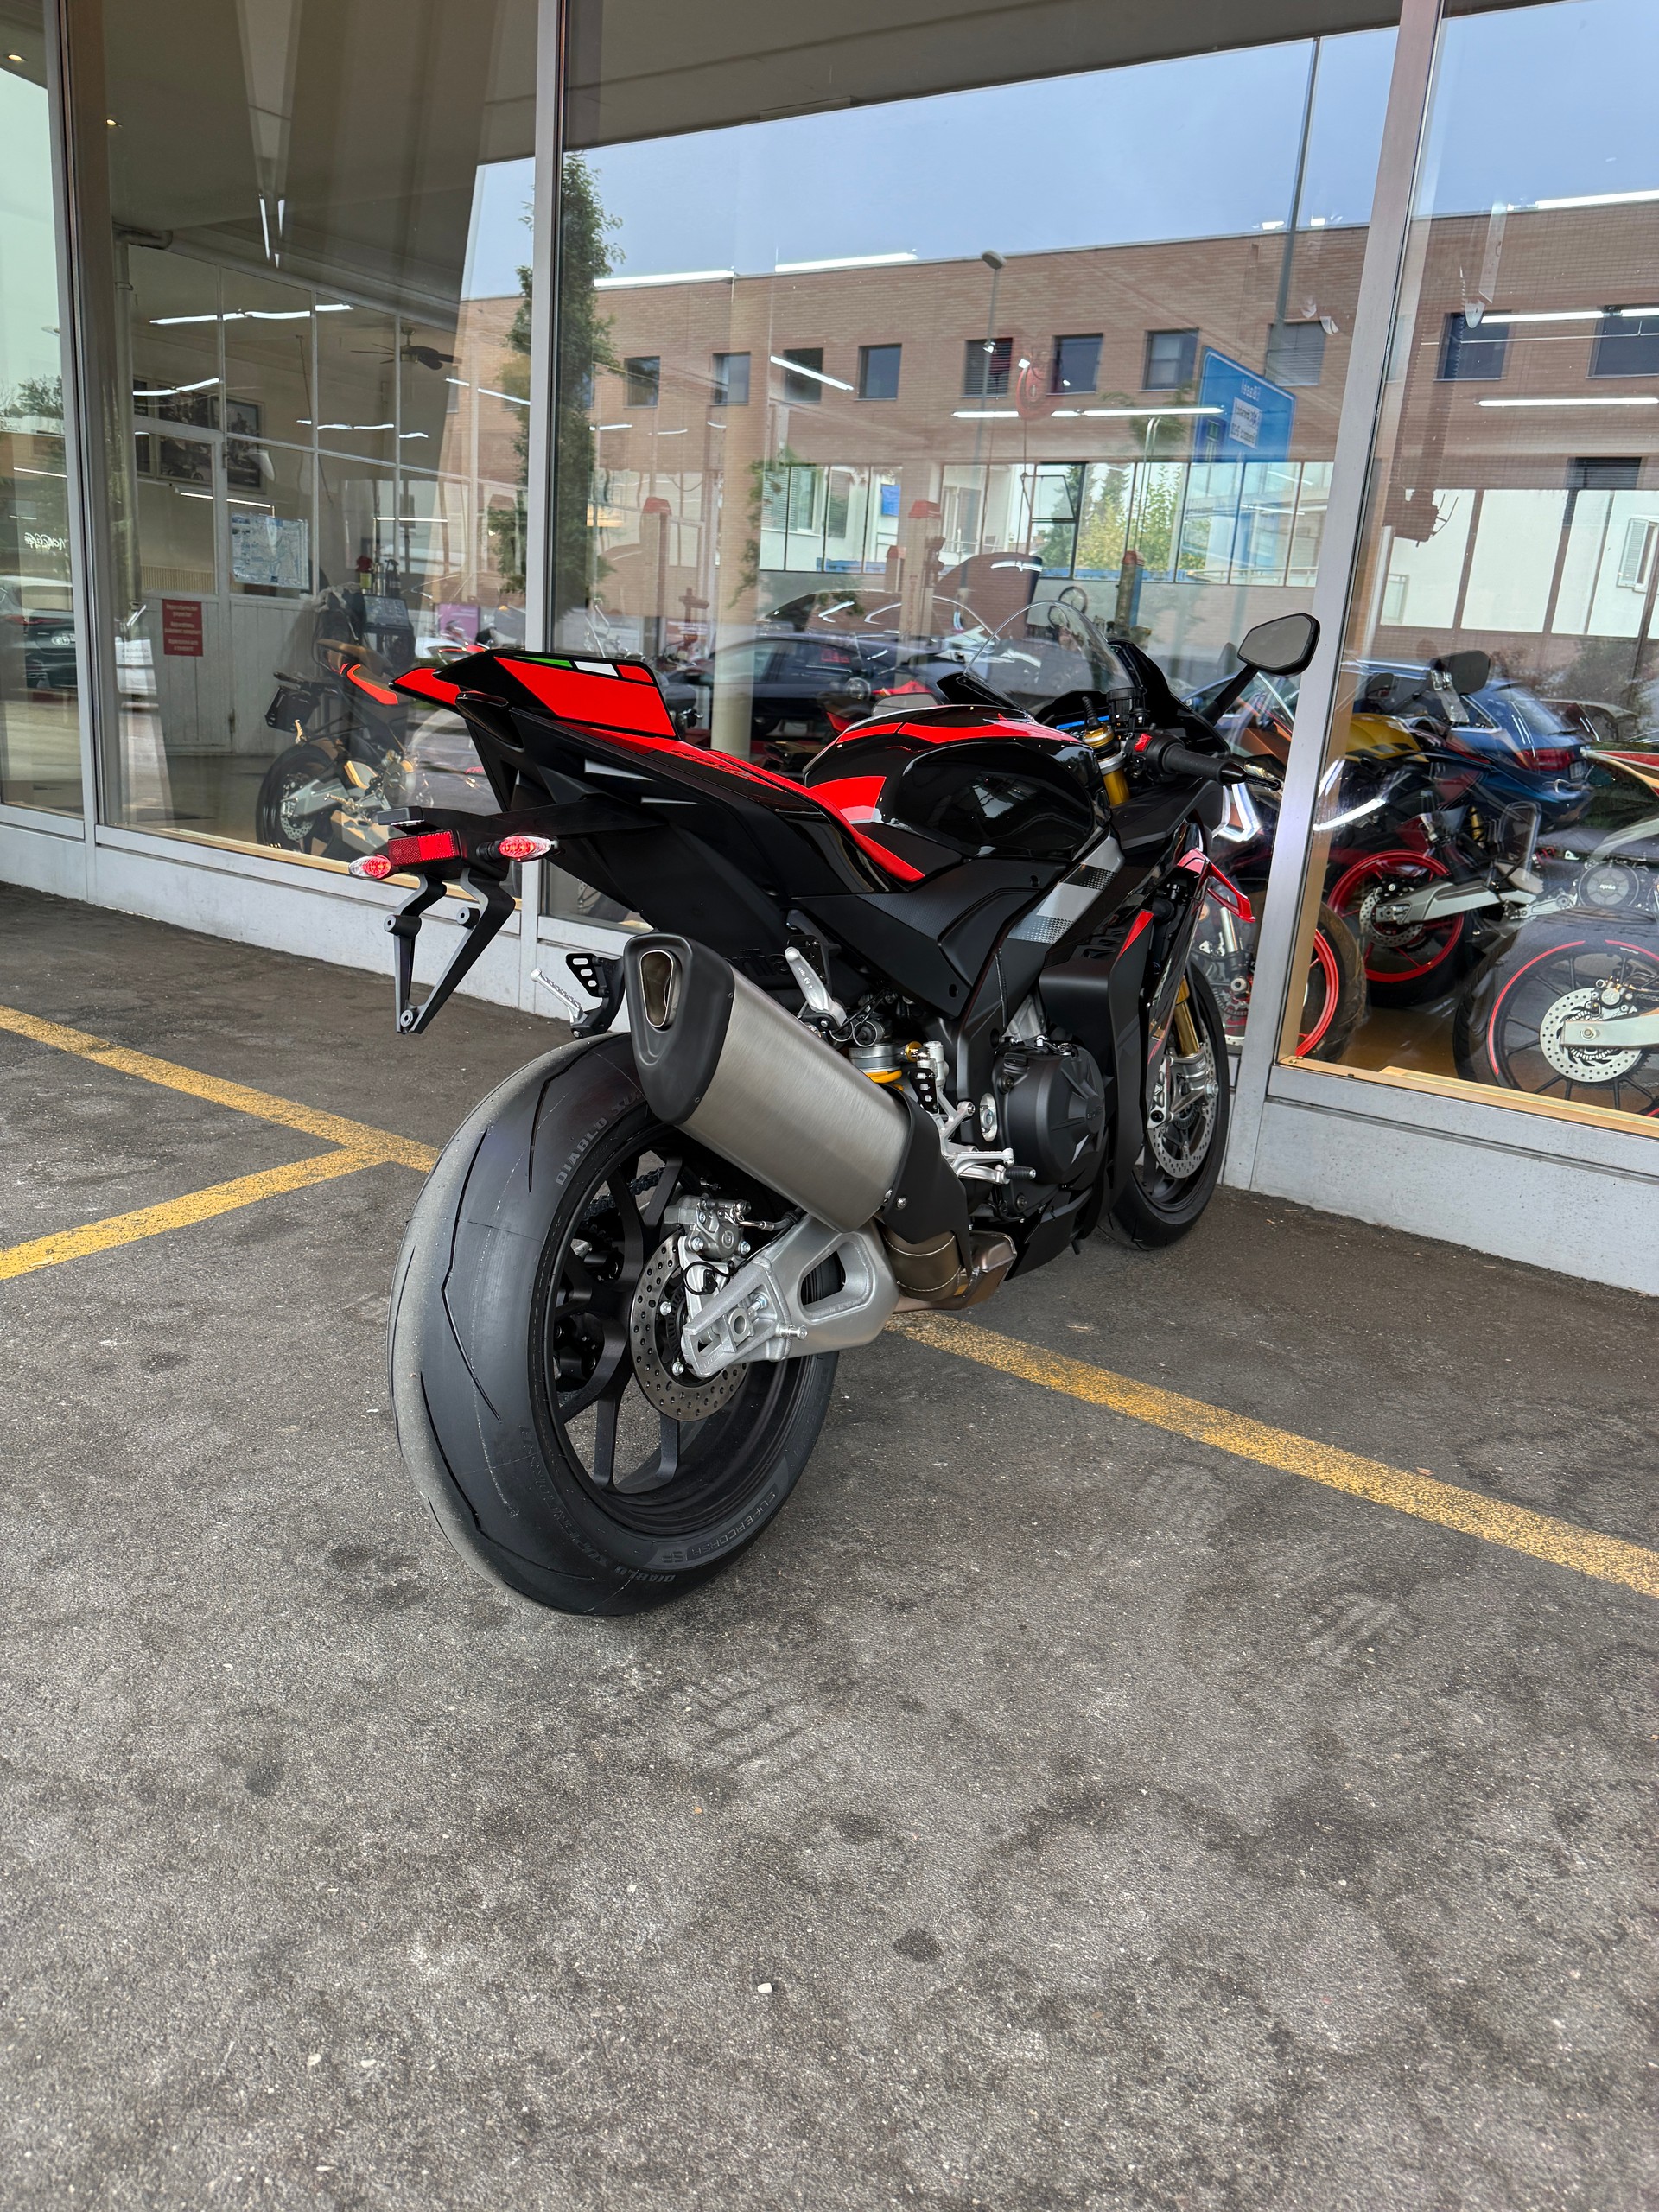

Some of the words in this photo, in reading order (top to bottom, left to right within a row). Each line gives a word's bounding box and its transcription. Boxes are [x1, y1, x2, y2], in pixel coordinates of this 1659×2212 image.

[555, 1117, 608, 1185] DIABLO
[691, 1492, 777, 1556] SUPERCORSA
[614, 1564, 676, 1583] DIABLO
